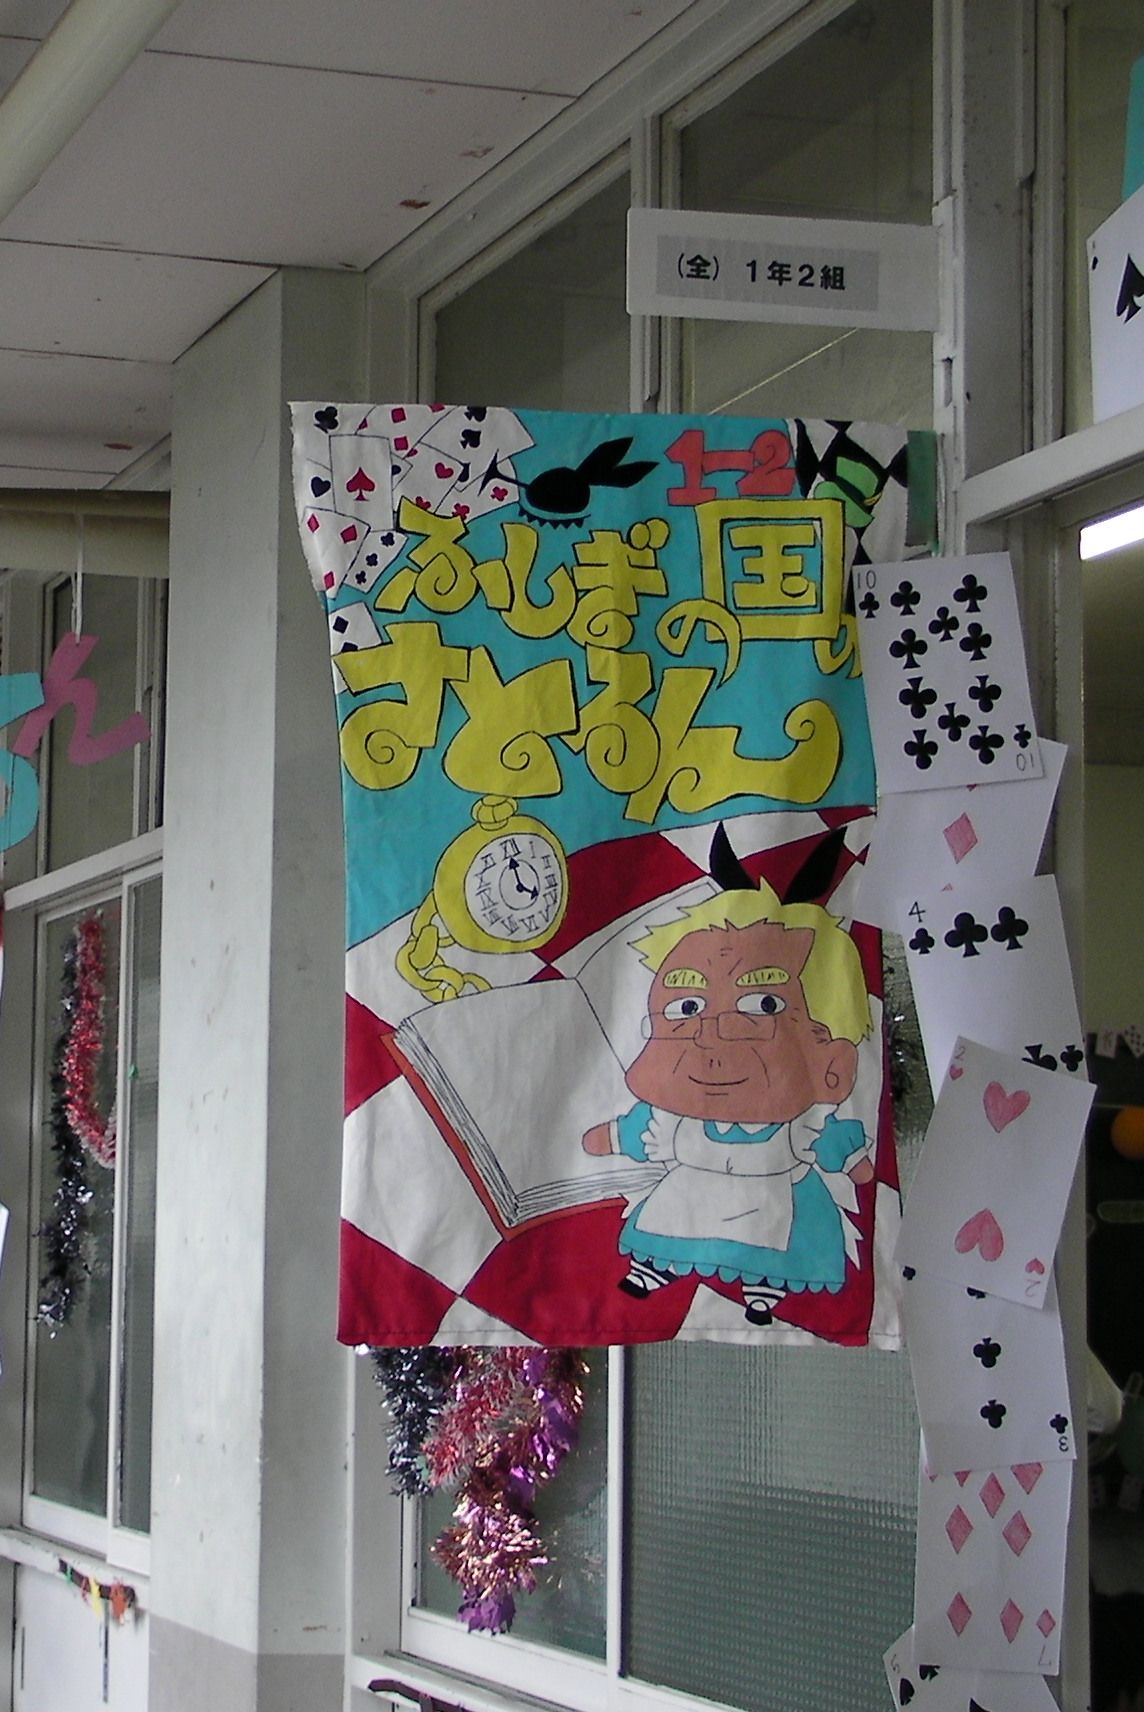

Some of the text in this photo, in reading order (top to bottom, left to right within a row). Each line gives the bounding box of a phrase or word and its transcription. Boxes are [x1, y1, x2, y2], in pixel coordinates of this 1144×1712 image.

[677, 253, 846, 291] (全) 1年2組
[664, 429, 796, 506] 1-2
[857, 570, 876, 590] 10
[332, 622, 844, 824] さとるん
[1016, 753, 1034, 772] 10
[908, 901, 926, 923] 4
